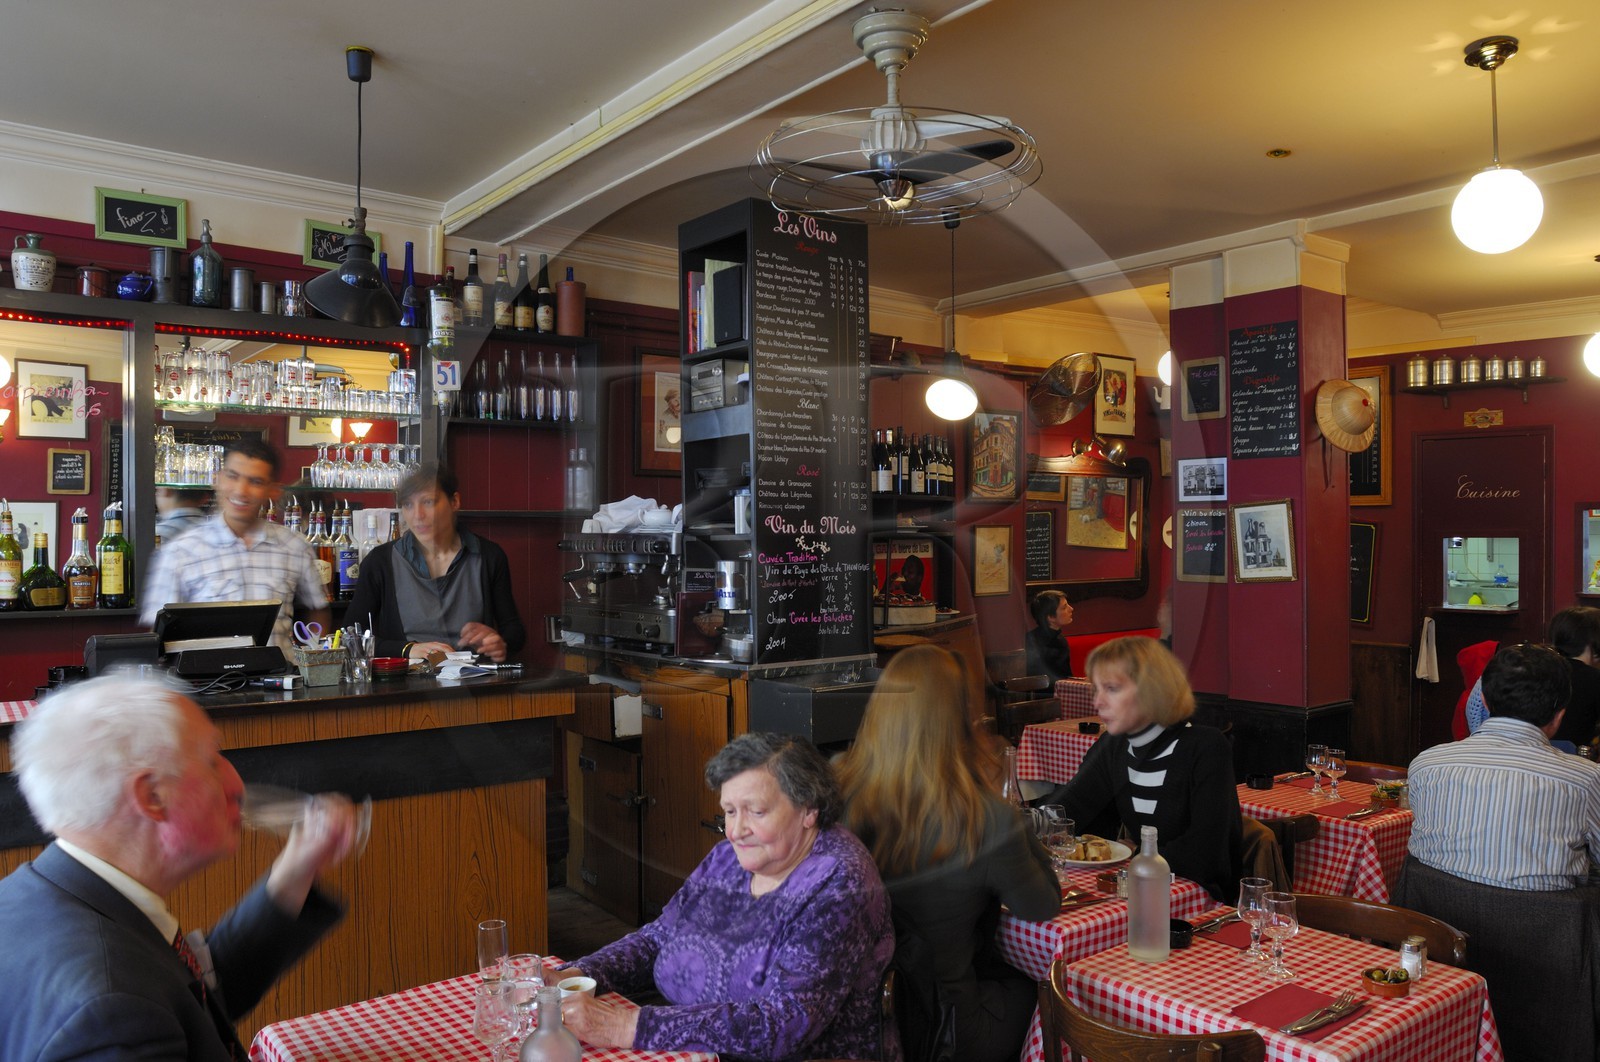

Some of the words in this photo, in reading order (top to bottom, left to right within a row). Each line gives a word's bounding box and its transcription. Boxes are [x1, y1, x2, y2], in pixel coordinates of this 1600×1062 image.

[773, 211, 799, 235] Les
[799, 215, 837, 243] Vins
[771, 252, 788, 261] Maison
[756, 290, 776, 300] Bordeaux
[437, 363, 456, 386] 51
[797, 398, 820, 410] Blanc
[757, 419, 777, 428] Domaine
[796, 464, 821, 477] Rosé
[758, 478, 777, 486] Domaine
[1456, 474, 1521, 499] Cuisine
[758, 489, 779, 498] Château
[780, 490, 789, 498] des
[764, 515, 797, 534] Vin
[800, 519, 816, 534] du
[819, 515, 857, 535] Mois
[757, 553, 785, 564] Cuvée
[785, 551, 818, 563] Tradition
[764, 565, 780, 581] Vin
[782, 564, 792, 575] de
[766, 612, 787, 625] Chinon
[810, 612, 821, 623] les
